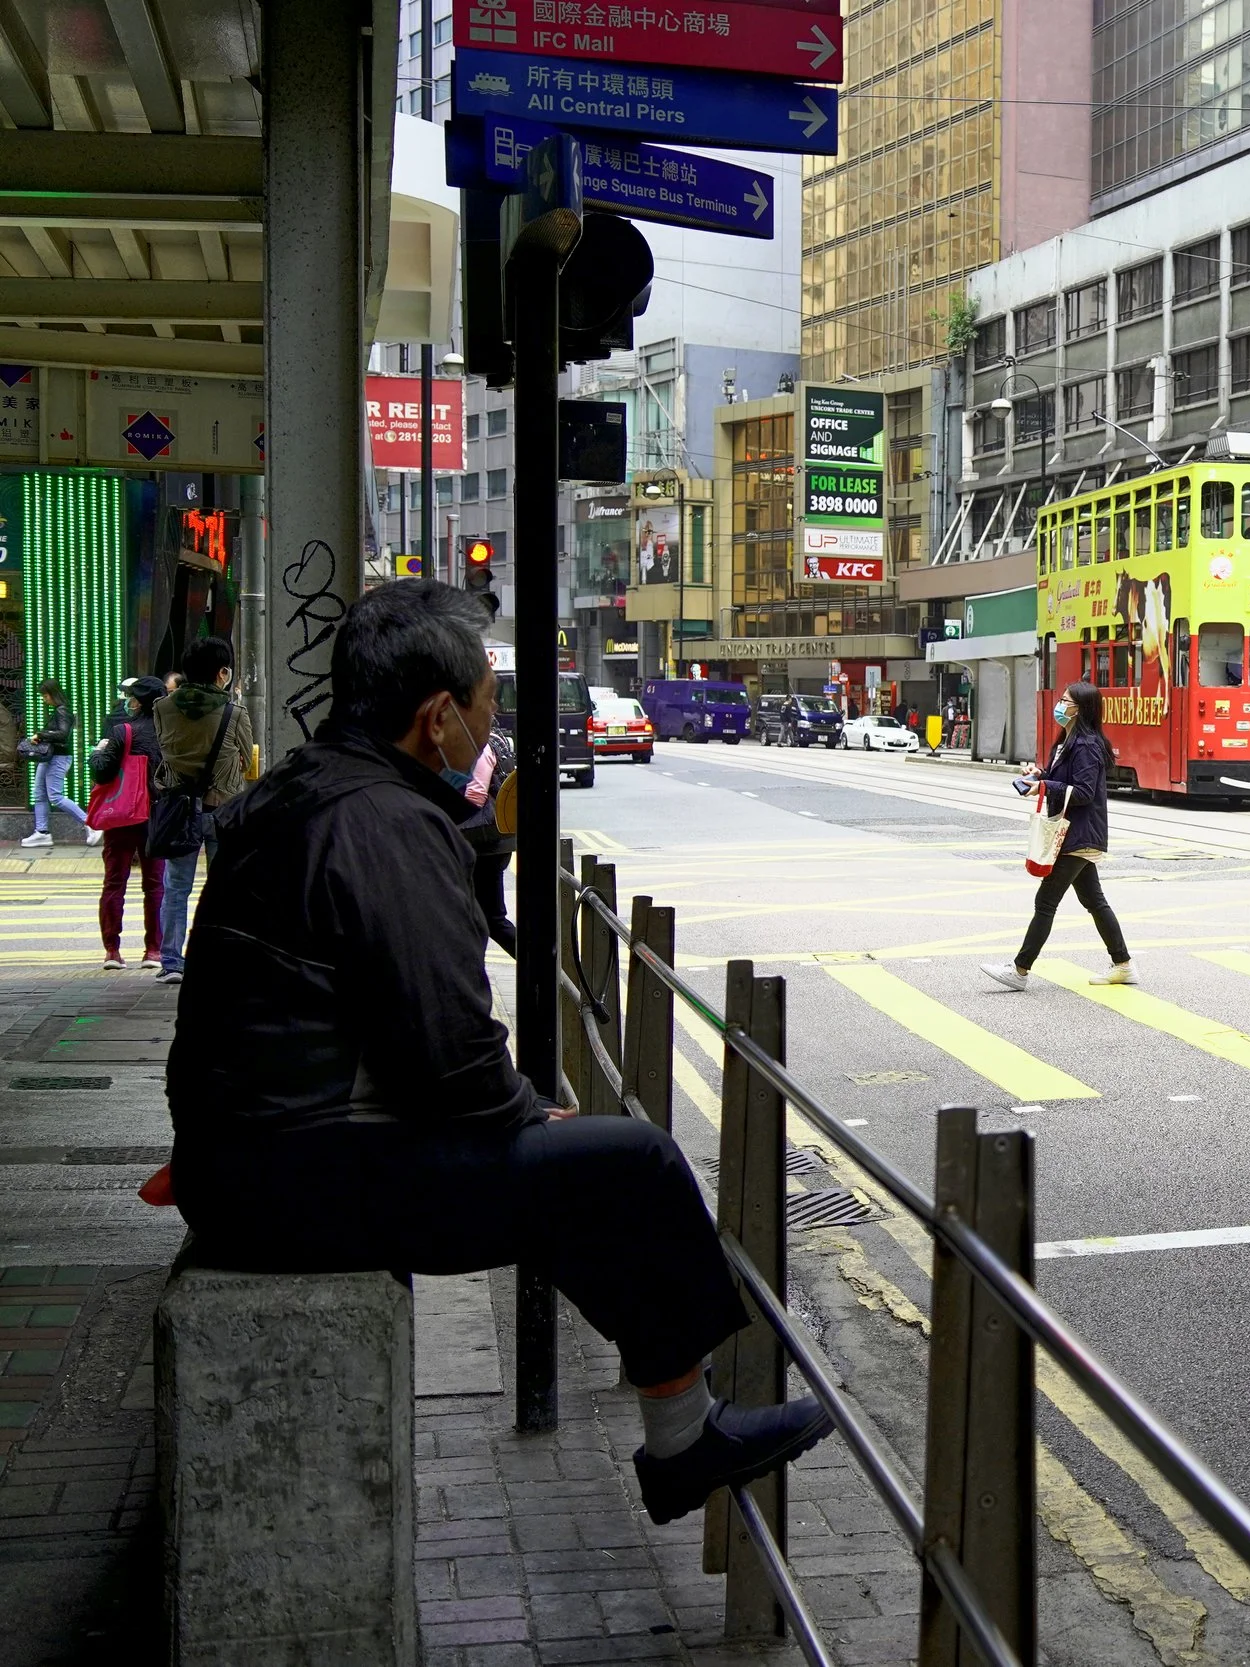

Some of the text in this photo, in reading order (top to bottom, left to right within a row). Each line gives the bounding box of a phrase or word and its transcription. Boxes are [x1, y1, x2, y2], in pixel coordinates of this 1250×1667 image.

[533, 0, 731, 37] 國際金融中心商場
[533, 31, 614, 53] IFC Mall
[527, 65, 674, 100] 所有中環碼頭
[528, 94, 685, 123] All Central Piers
[611, 179, 656, 199] Square
[660, 187, 683, 205] Bus
[686, 192, 738, 216] Terminus
[390, 420, 418, 429] please
[810, 417, 848, 431] OFFICE
[127, 432, 169, 440] ROMIKA
[810, 430, 833, 443] AND
[810, 443, 858, 457] SIGNAGE
[811, 475, 877, 494] FOR LEASE
[810, 495, 877, 514] 3898 0000
[808, 534, 838, 549] UP
[840, 535, 878, 545] ULTIMATE
[840, 543, 878, 552] PERFORMANCE
[836, 562, 876, 577] KFC
[720, 642, 836, 657] UNICORN TRADE CENTRE
[1102, 697, 1164, 726] ORNED BEEF
